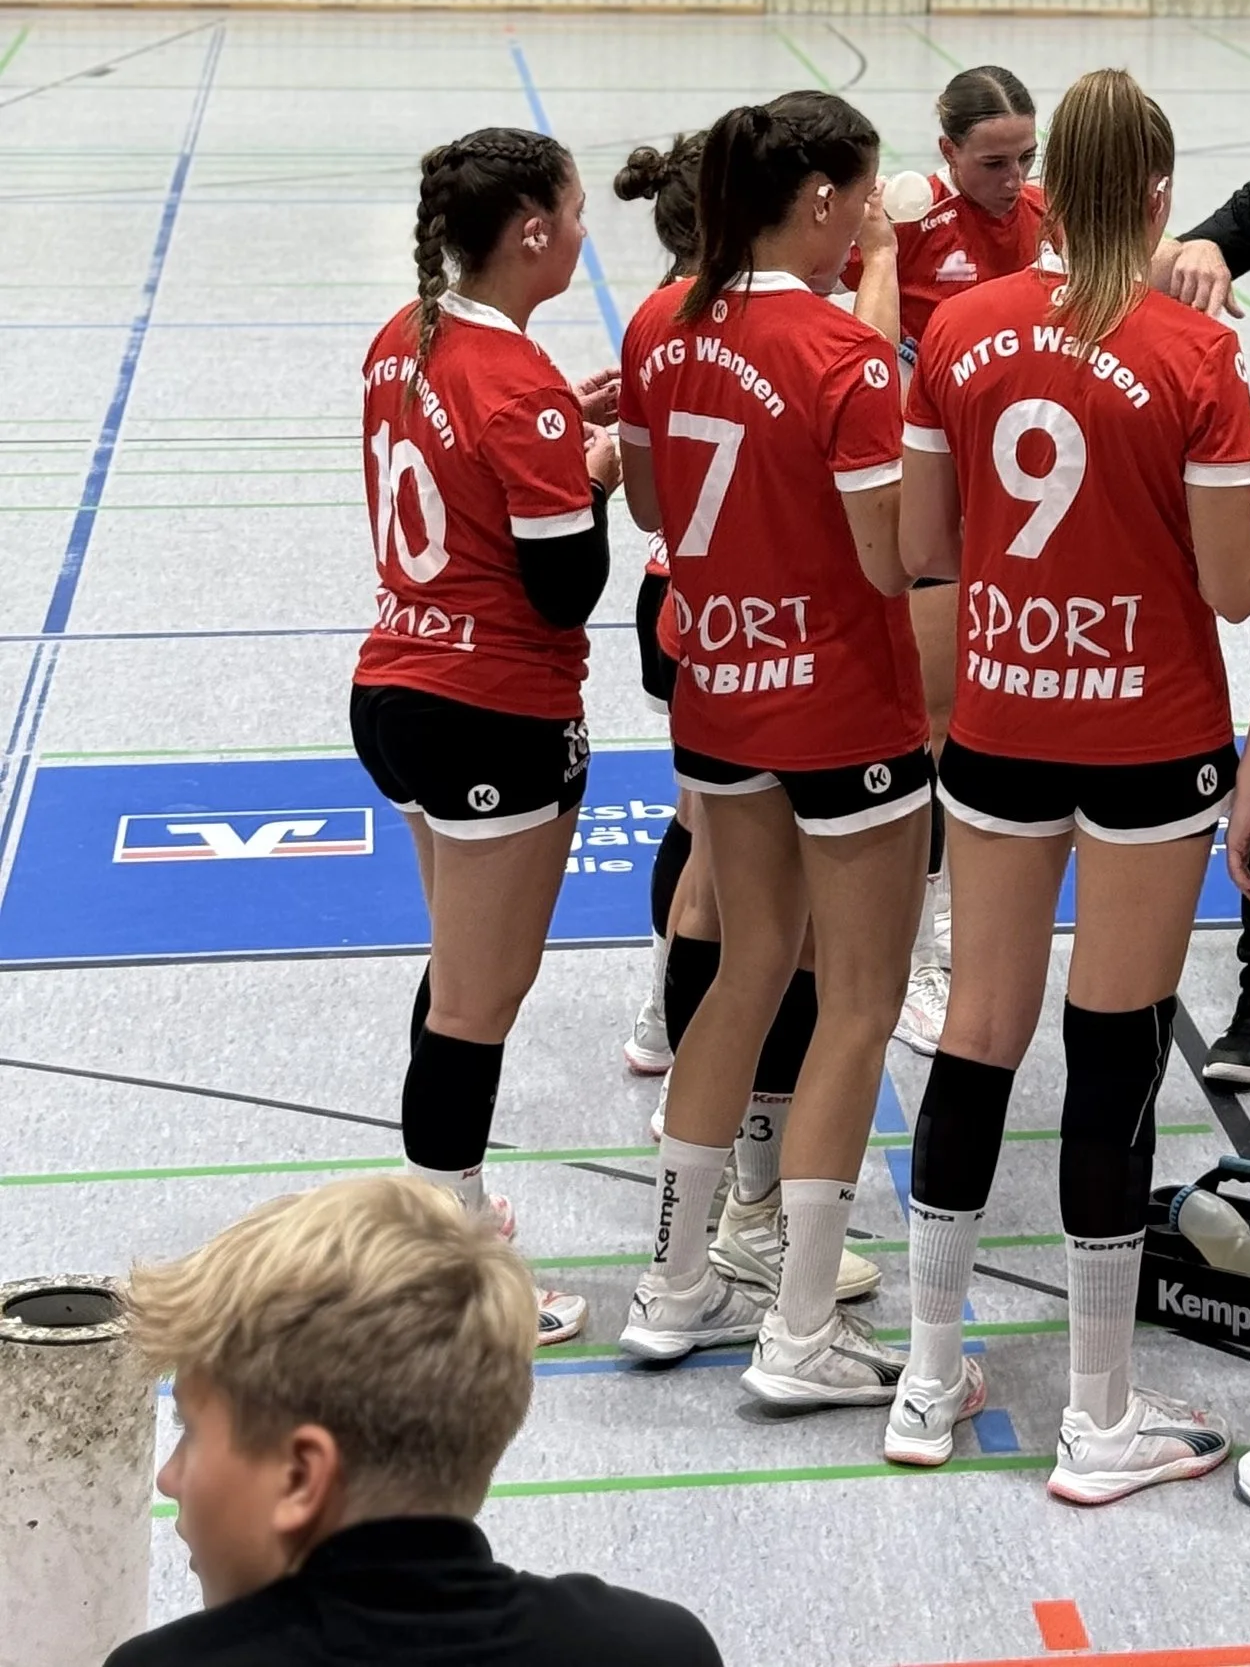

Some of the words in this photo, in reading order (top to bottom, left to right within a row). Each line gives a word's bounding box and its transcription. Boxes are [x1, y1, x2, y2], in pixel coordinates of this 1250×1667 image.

[638, 336, 686, 391] MTG
[695, 335, 787, 418] Wangen
[949, 328, 1022, 389] MTG
[371, 419, 450, 584] 10
[667, 409, 746, 558] 7
[992, 397, 1087, 560] 9
[674, 588, 811, 652] ORT
[968, 580, 1143, 659] SPORT
[681, 652, 816, 695] RBINE
[966, 650, 1146, 701] TURBINE
[654, 1168, 680, 1264] Kempa
[1073, 1236, 1145, 1251] Kemp
